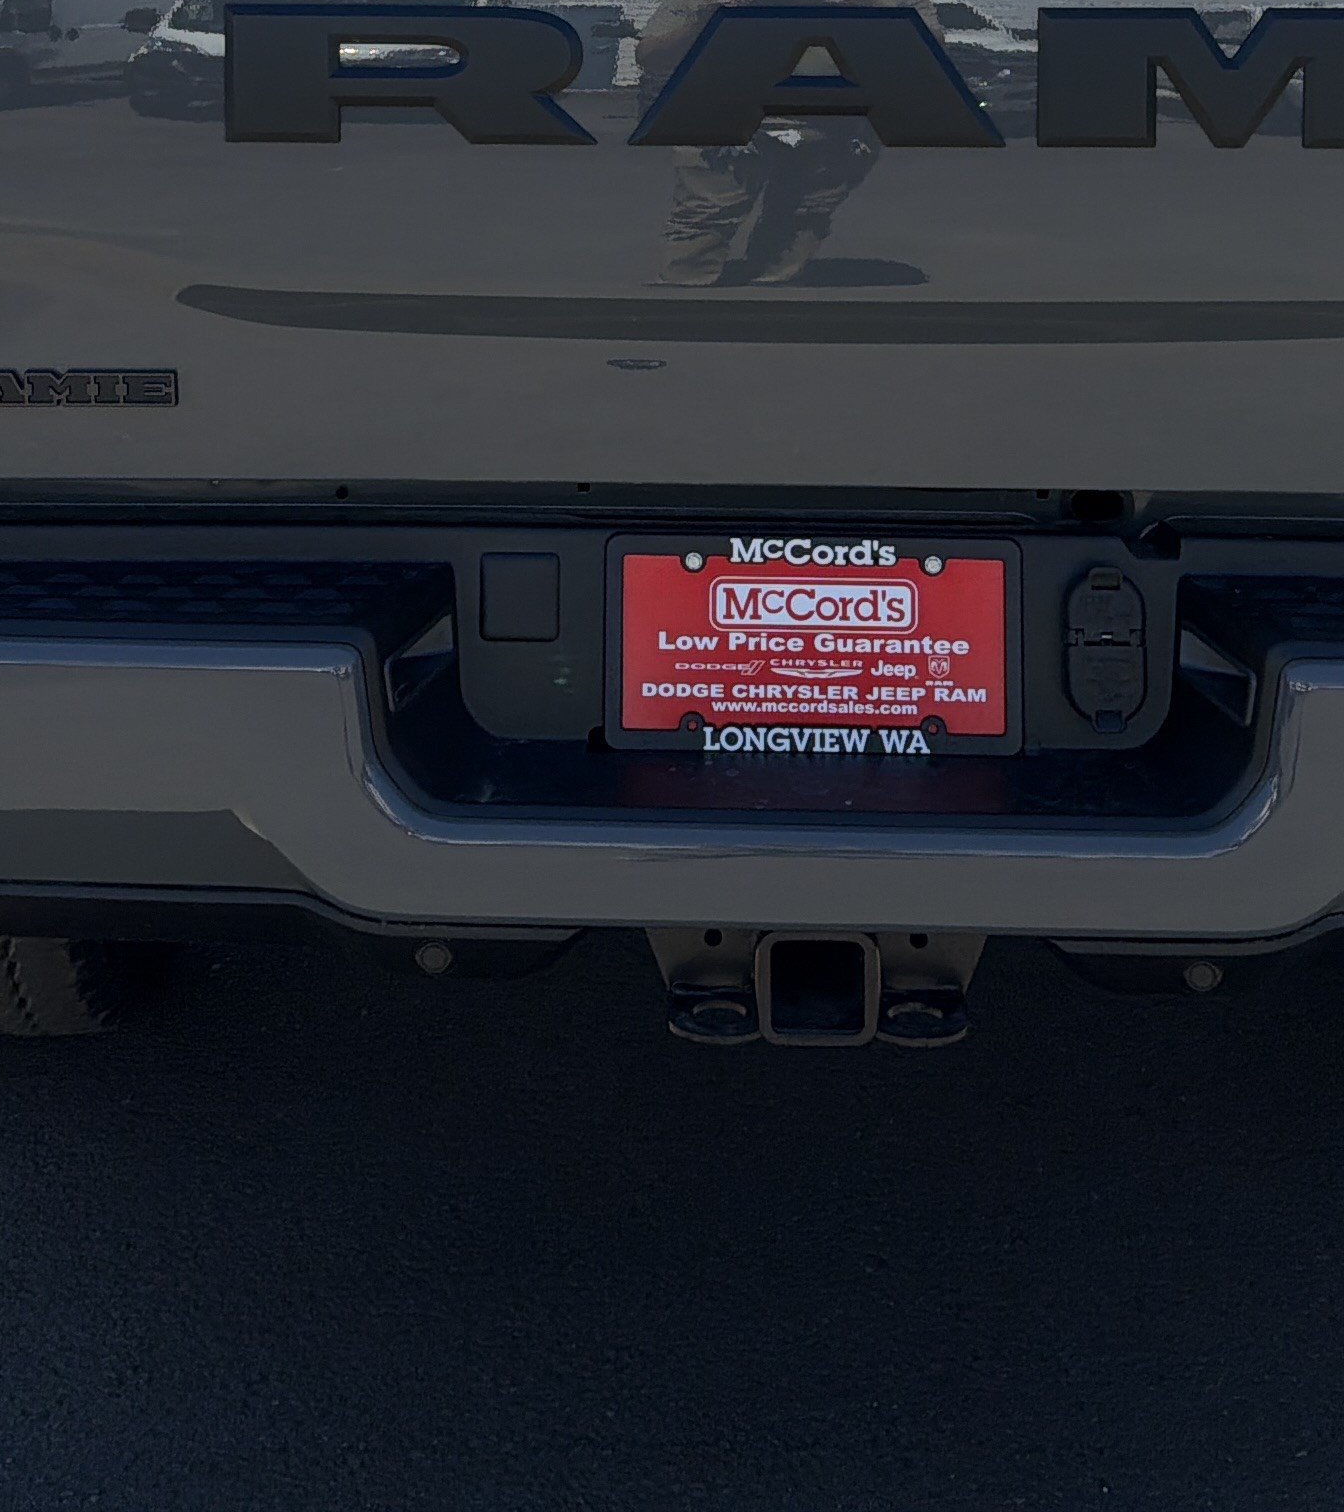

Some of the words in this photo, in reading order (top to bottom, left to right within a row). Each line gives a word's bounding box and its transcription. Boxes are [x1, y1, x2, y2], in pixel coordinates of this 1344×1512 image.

[730, 537, 896, 567] McCord's
[722, 587, 905, 623] McCord's
[658, 631, 719, 651] Low
[729, 633, 804, 652] Price
[814, 634, 970, 655] Guarantee
[674, 662, 750, 671] DODGE
[769, 658, 864, 668] CHRYSLER
[870, 659, 917, 680] Jeep
[642, 683, 725, 698] DODGE
[731, 685, 859, 700] CHRYSLER
[865, 687, 927, 701] JEEP
[933, 688, 987, 703] RAM
[711, 700, 918, 715] www.mccordsales.com
[703, 726, 870, 752] LONGVIEW
[878, 729, 930, 754] WA
